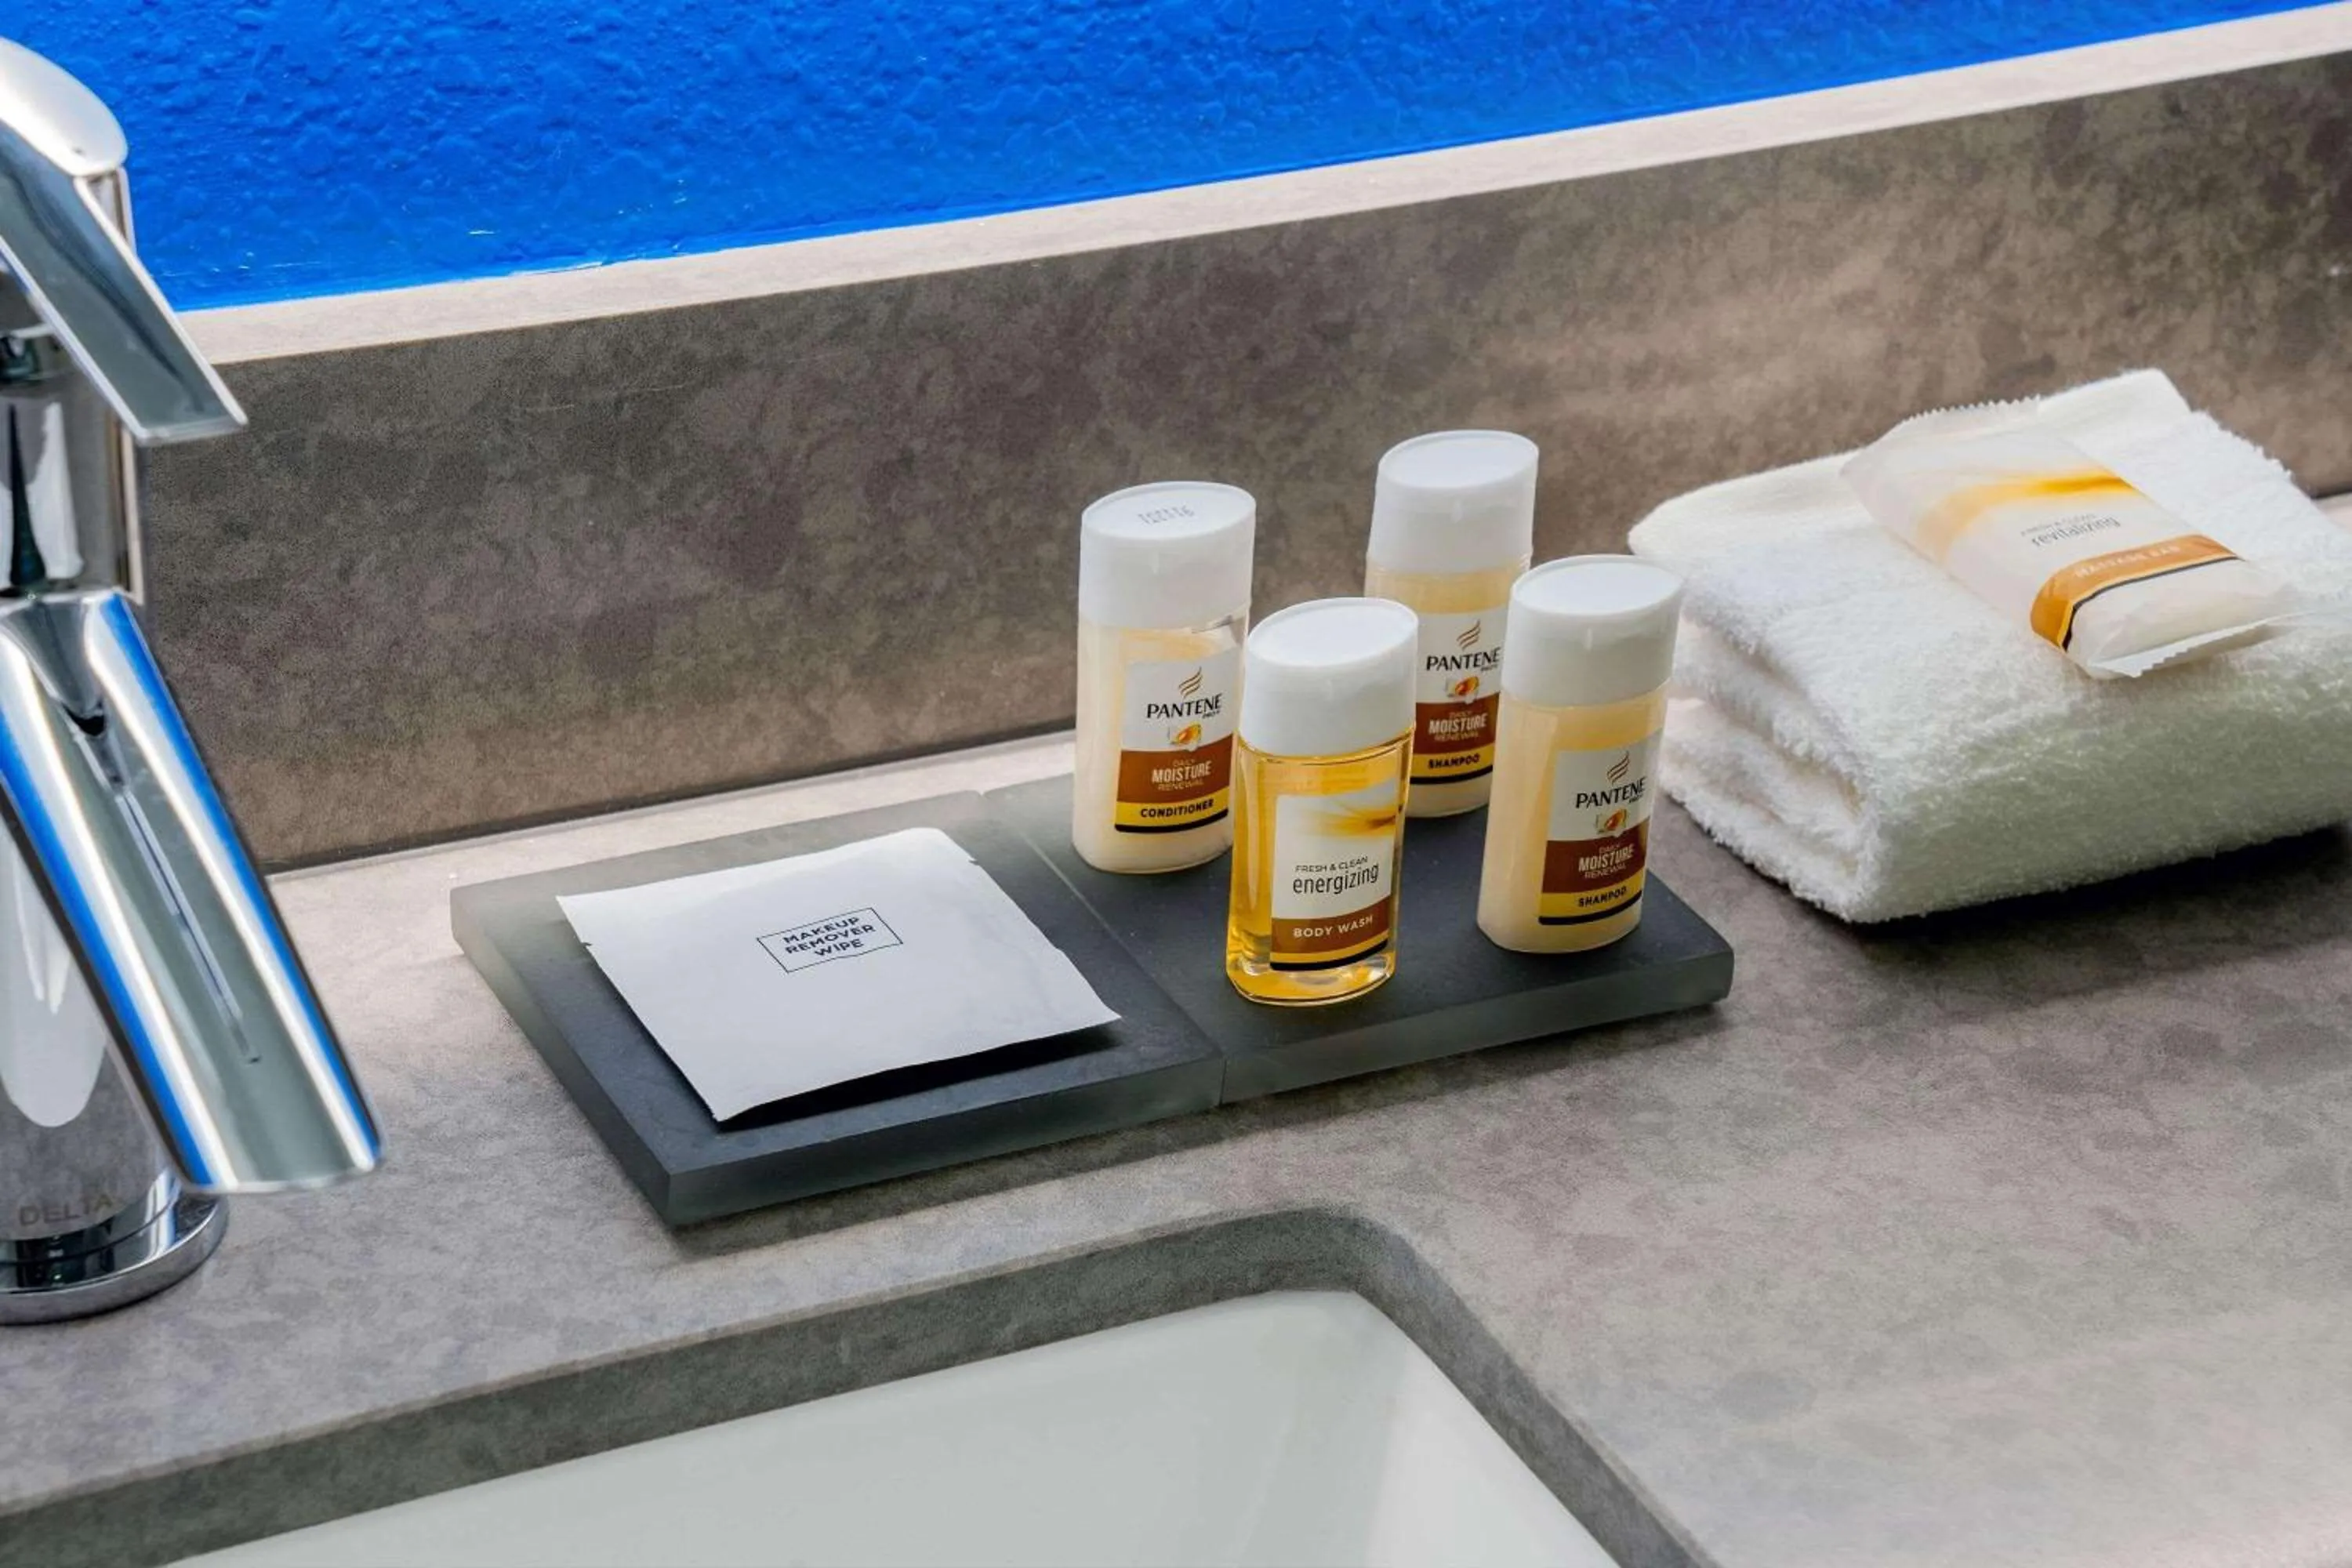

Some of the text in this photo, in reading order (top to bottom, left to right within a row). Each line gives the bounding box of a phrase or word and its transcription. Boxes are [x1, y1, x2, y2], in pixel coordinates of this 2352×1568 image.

[1426, 647, 1501, 671] PANTENE
[1147, 693, 1222, 718] PANTENE
[1428, 713, 1488, 735] MOISTURE
[1152, 760, 1213, 782] MOISTURE
[1428, 753, 1480, 768] SHAMPOO
[1575, 776, 1647, 808] PANTENE
[1141, 798, 1214, 818] CONDITIONER
[1338, 855, 1368, 869] CLEAN
[1578, 844, 1635, 873] MOISTURE
[1293, 862, 1379, 895] energizing
[1578, 886, 1628, 907] SHAMPOO
[782, 916, 860, 944] MAKEUP
[1293, 914, 1374, 938] BODY WASH
[785, 924, 877, 954] REMOVER
[814, 938, 864, 956] WIPE
